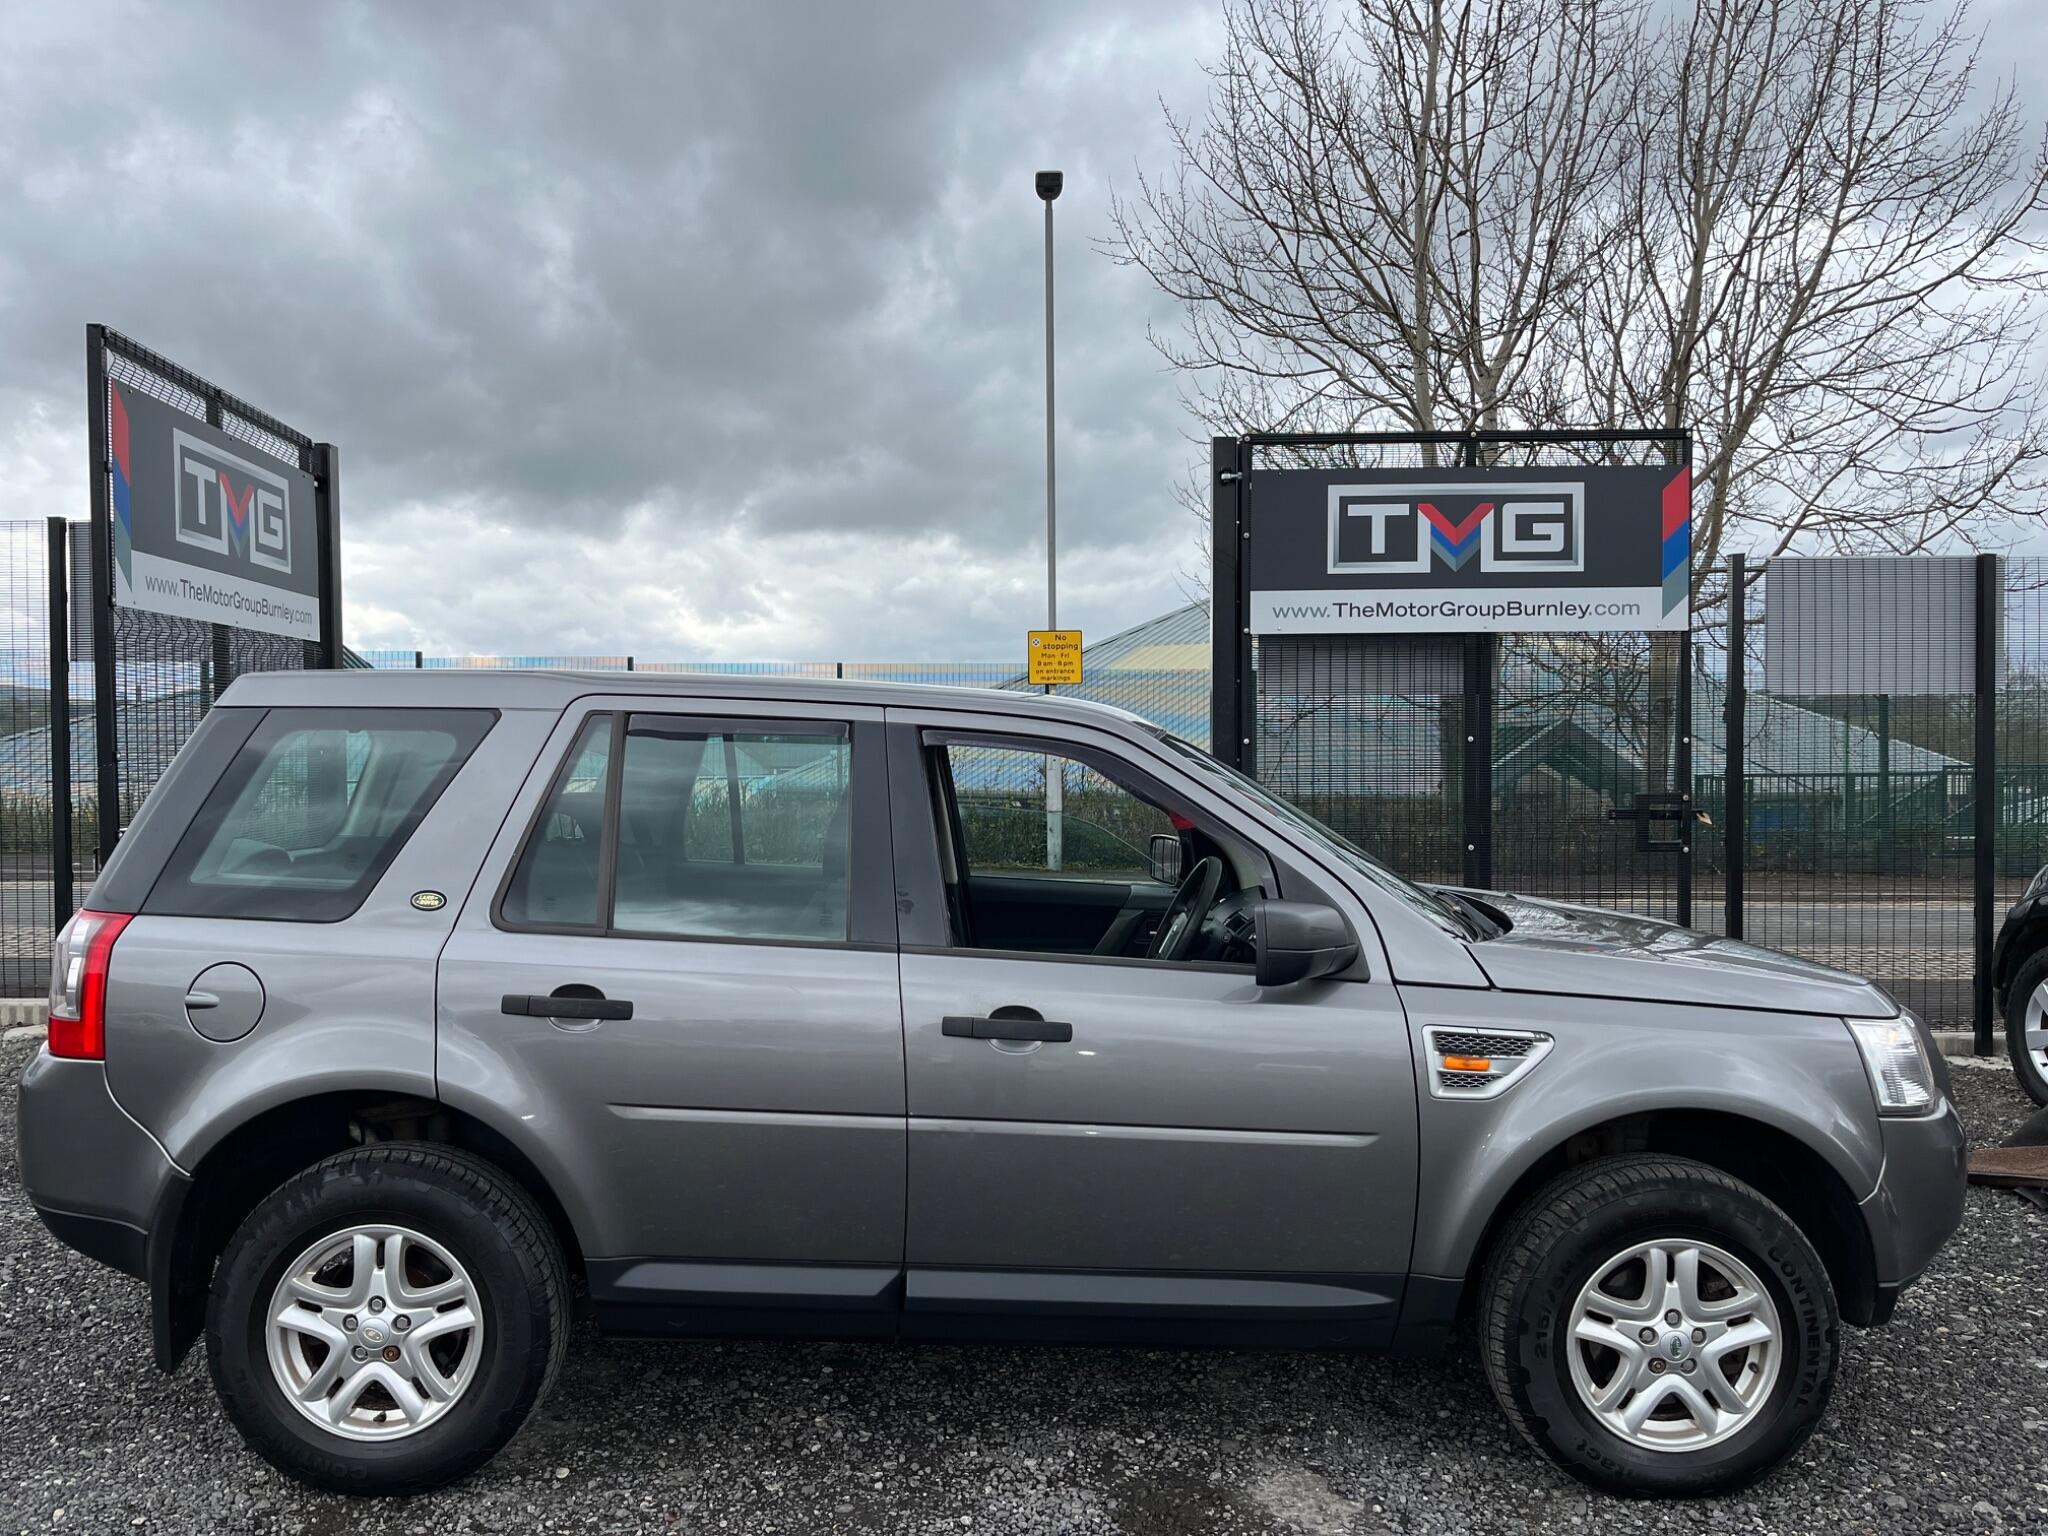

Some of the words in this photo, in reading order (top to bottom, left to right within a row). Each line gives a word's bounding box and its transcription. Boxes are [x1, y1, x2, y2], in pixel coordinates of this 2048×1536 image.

[184, 456, 284, 558] TMG
[1346, 502, 1565, 573] TMG
[145, 574, 313, 626] www.TheMotorGroupBurnley.com
[1272, 600, 1641, 621] www.TheMotorGroupBurnley.com
[1767, 1246, 1822, 1410] CONTINENTAL
